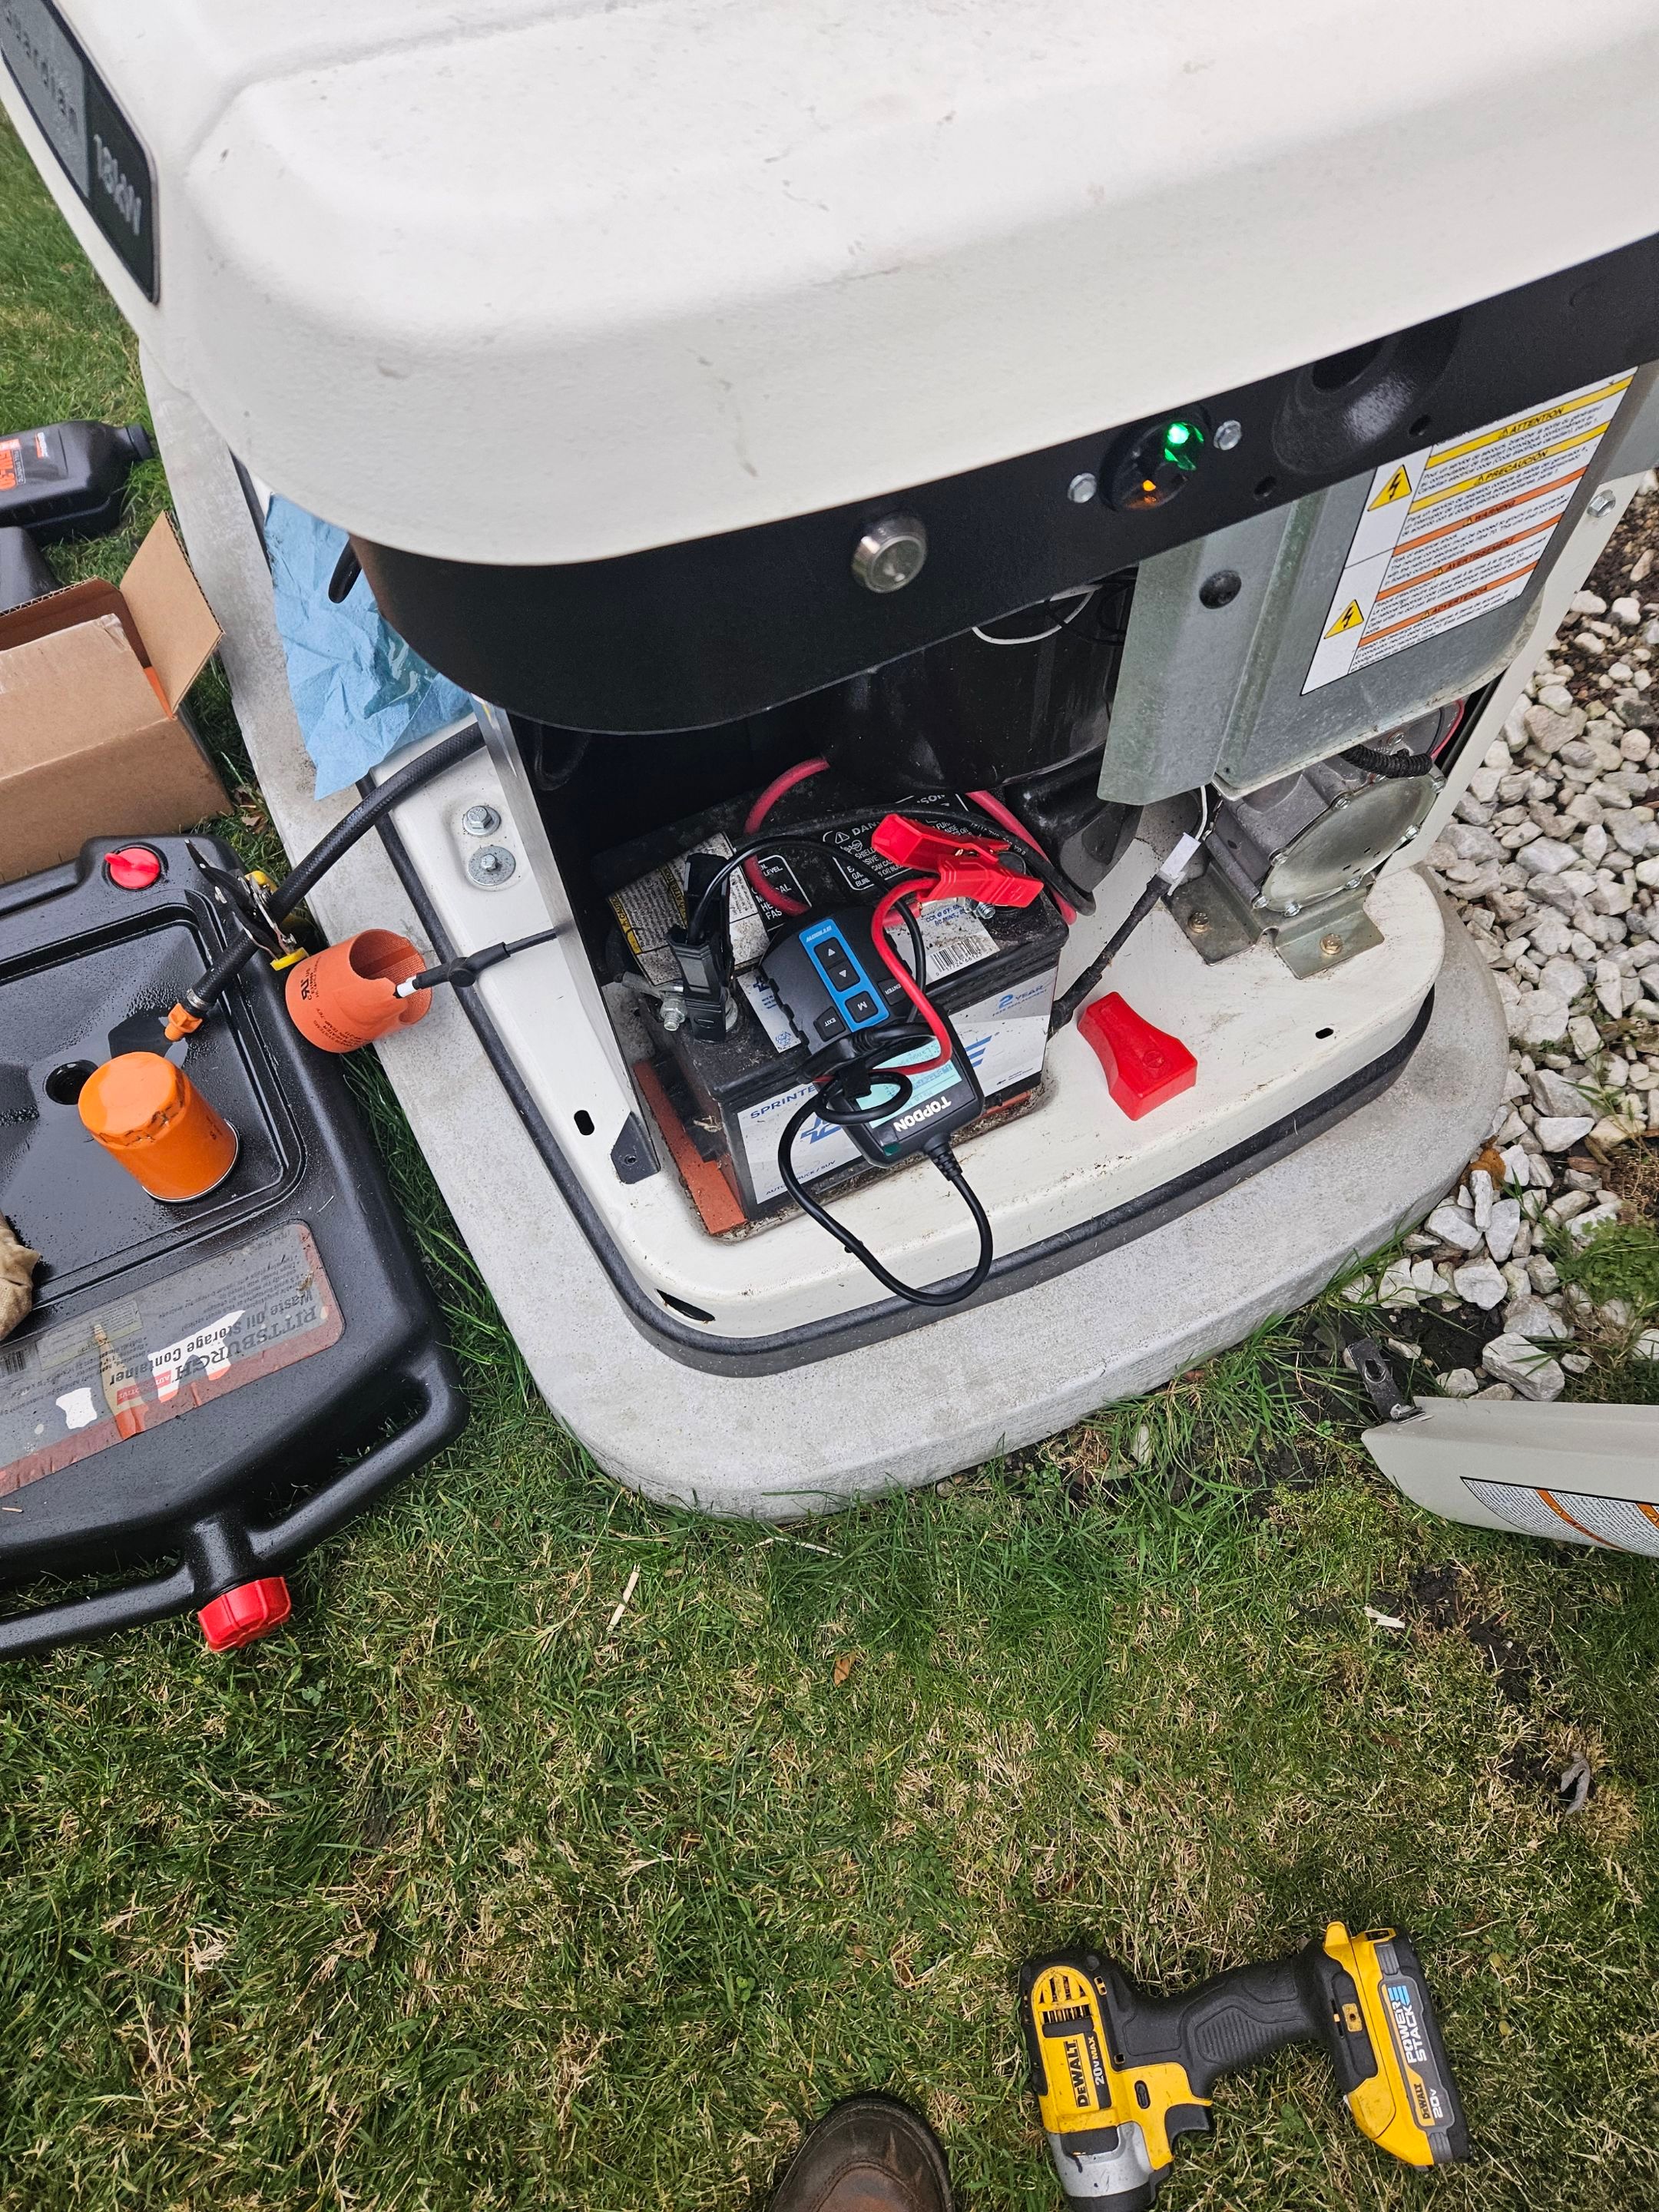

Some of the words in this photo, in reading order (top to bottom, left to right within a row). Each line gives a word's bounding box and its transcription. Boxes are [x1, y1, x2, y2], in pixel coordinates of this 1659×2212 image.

[1510, 406, 1564, 433] ATTENTION
[1472, 498, 1516, 523] WARNING
[856, 1001, 869, 1010] M
[997, 994, 1015, 1014] 2
[1015, 985, 1045, 1003] YEAR
[824, 1017, 837, 1028] EXIT
[750, 1085, 816, 1119] SPRINTE
[894, 1099, 952, 1134] TOPDON
[821, 1160, 836, 1169] SUV
[245, 1310, 267, 1329] Oil
[270, 1295, 313, 1318] Waste
[175, 1306, 317, 1380] PITTSBURGH
[187, 1319, 243, 1353] Storage
[110, 1347, 183, 1386] Container
[1392, 2001, 1417, 2063] POWER
[1403, 2005, 1427, 2062] STACK
[1088, 2036, 1098, 2059] MAX
